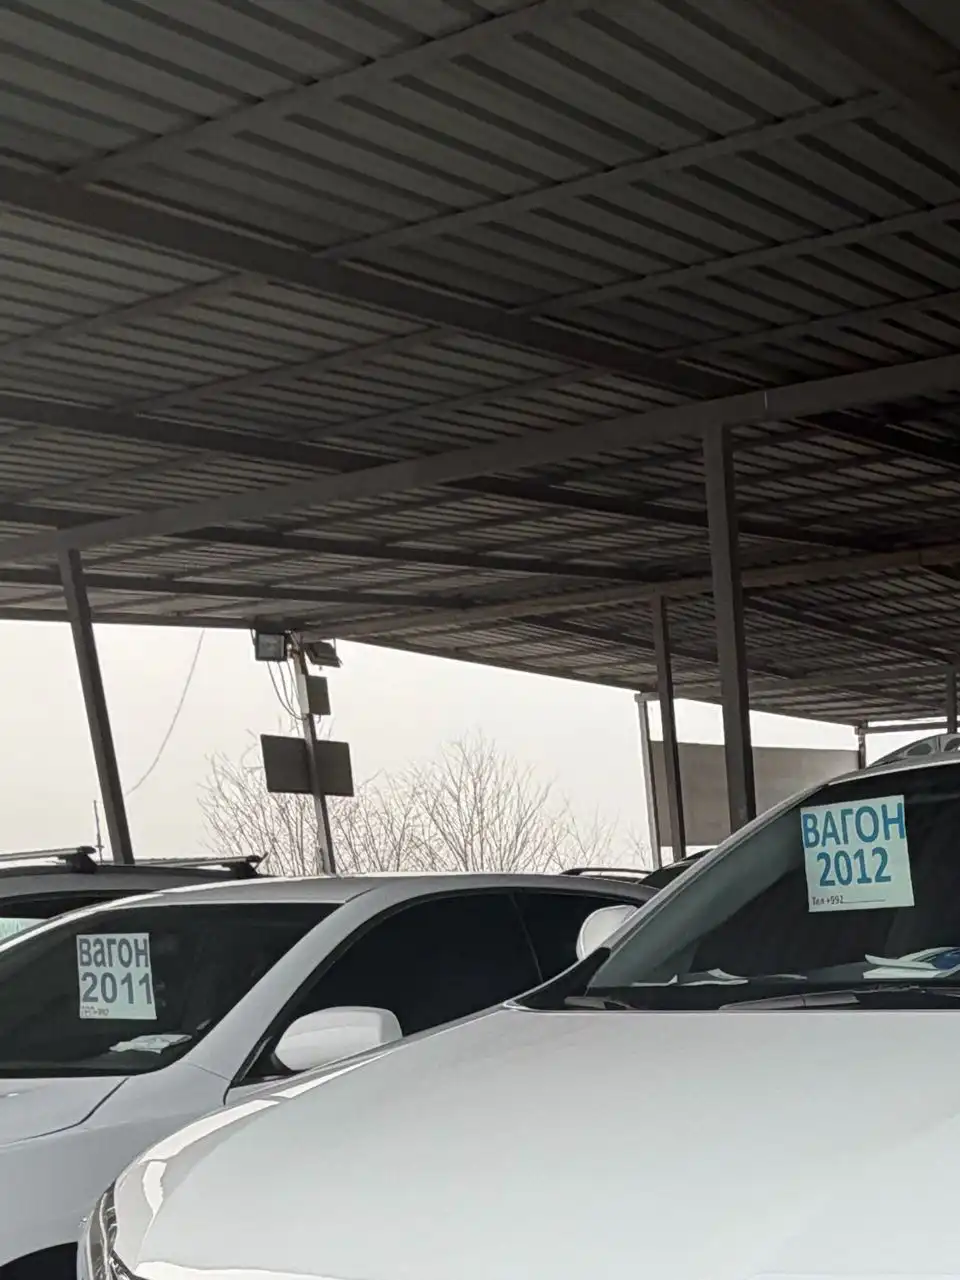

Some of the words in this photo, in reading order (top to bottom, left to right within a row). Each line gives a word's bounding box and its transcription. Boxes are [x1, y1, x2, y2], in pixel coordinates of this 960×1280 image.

[802, 802, 906, 848] ВАГОН
[817, 846, 892, 887] 2012
[81, 971, 153, 1004] 2011
